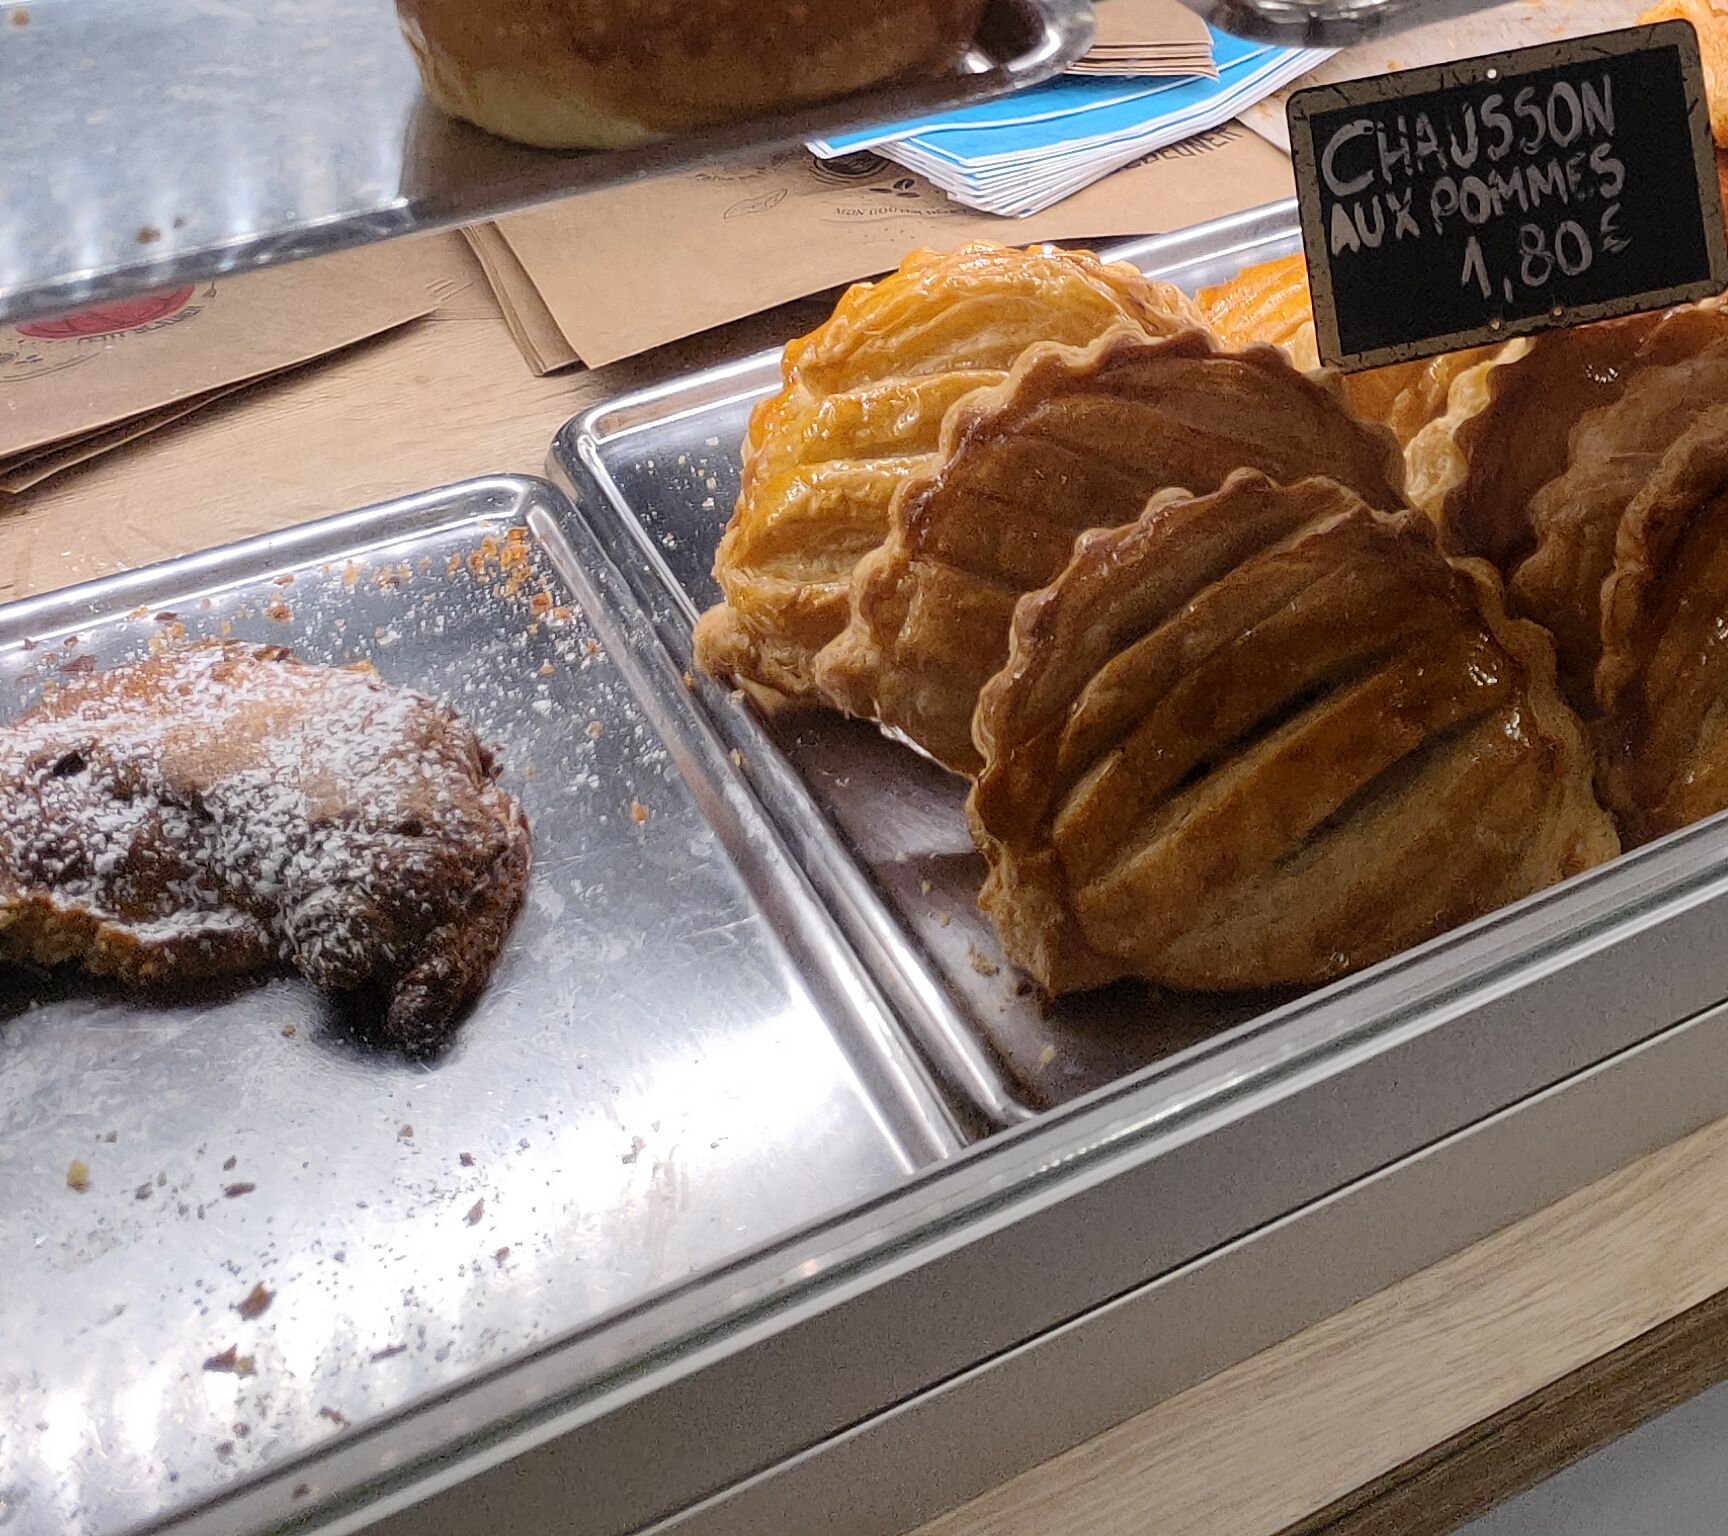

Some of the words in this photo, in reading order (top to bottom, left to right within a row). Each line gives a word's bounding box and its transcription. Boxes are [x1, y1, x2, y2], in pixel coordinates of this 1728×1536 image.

[1320, 73, 1617, 198] CHAUSSON
[1330, 188, 1421, 258] AUX
[1430, 142, 1627, 236] POMMES
[1460, 201, 1634, 304] 1,80€
